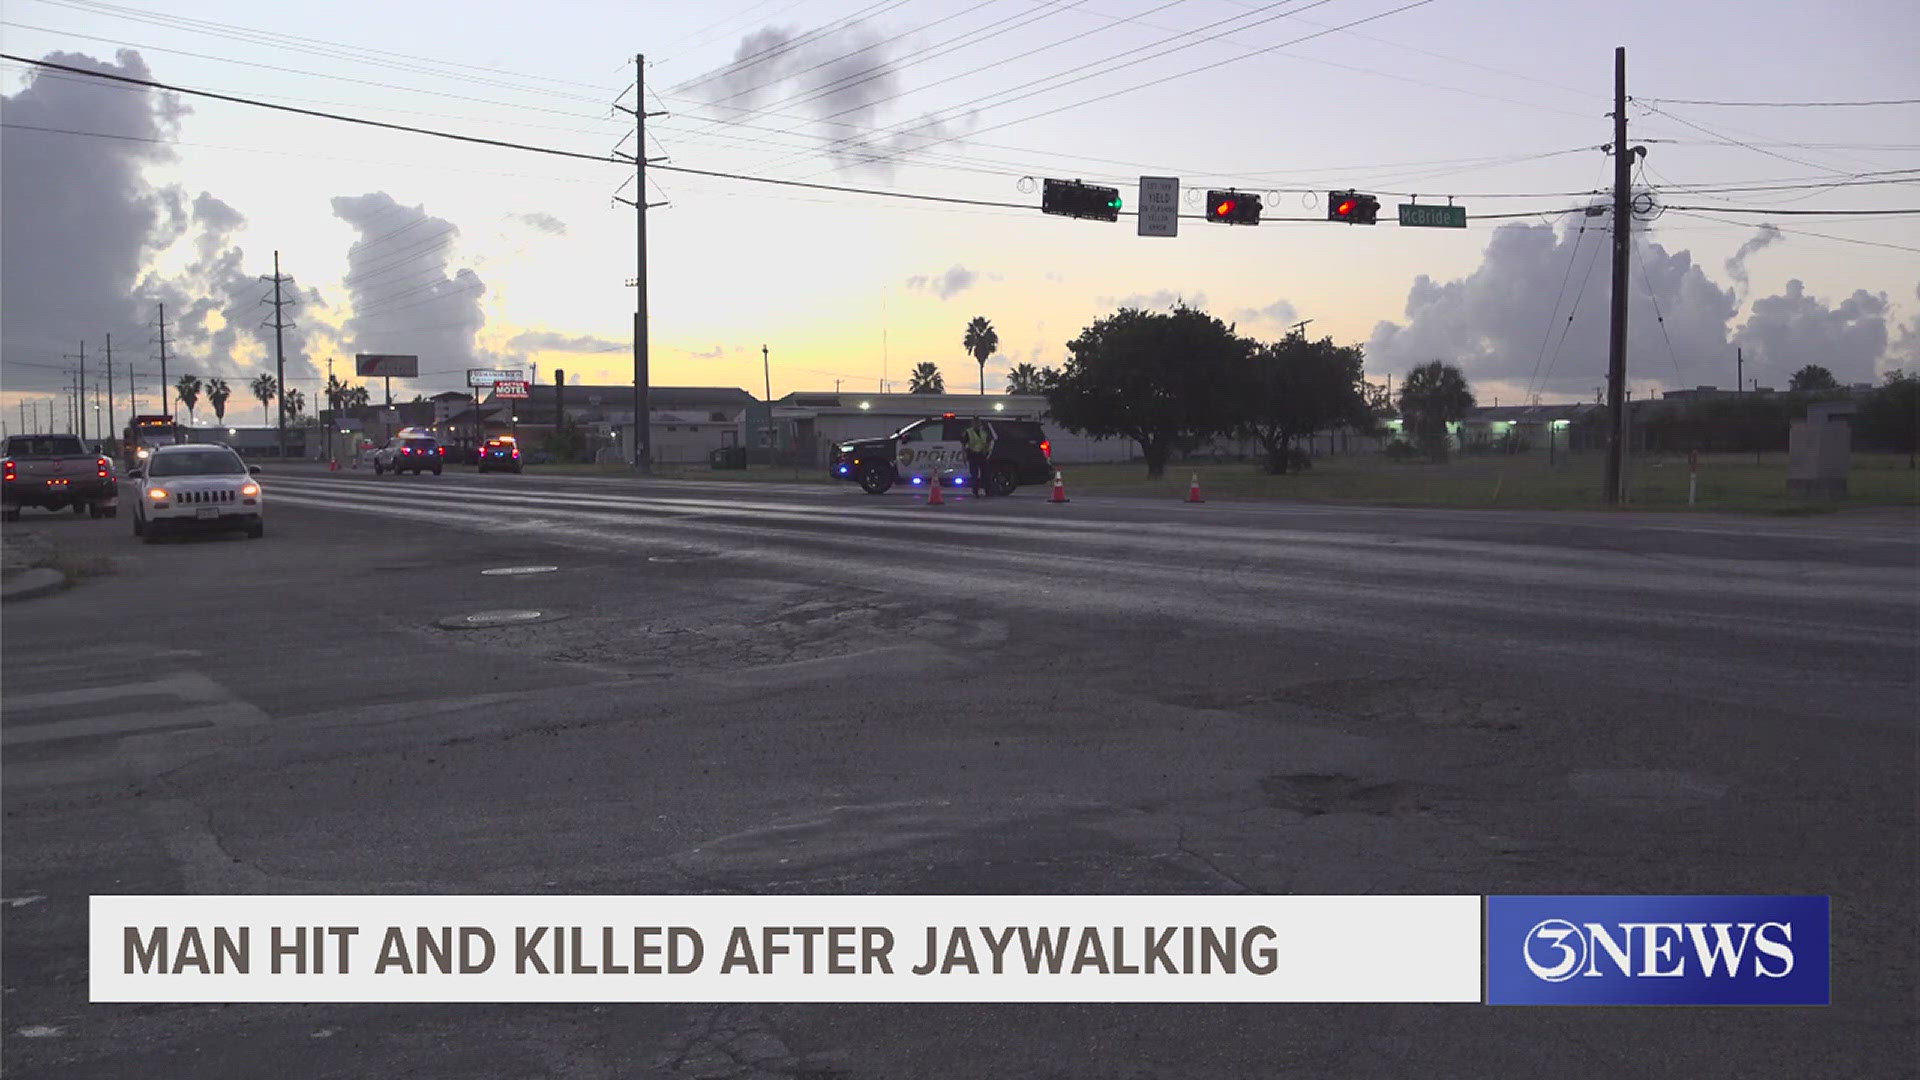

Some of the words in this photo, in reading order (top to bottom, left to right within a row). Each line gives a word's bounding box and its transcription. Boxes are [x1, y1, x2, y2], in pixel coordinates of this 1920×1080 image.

[1149, 192, 1170, 204] YIELD
[1401, 207, 1451, 225] McBride
[496, 386, 527, 394] MOTEL
[915, 450, 962, 462] POLIC
